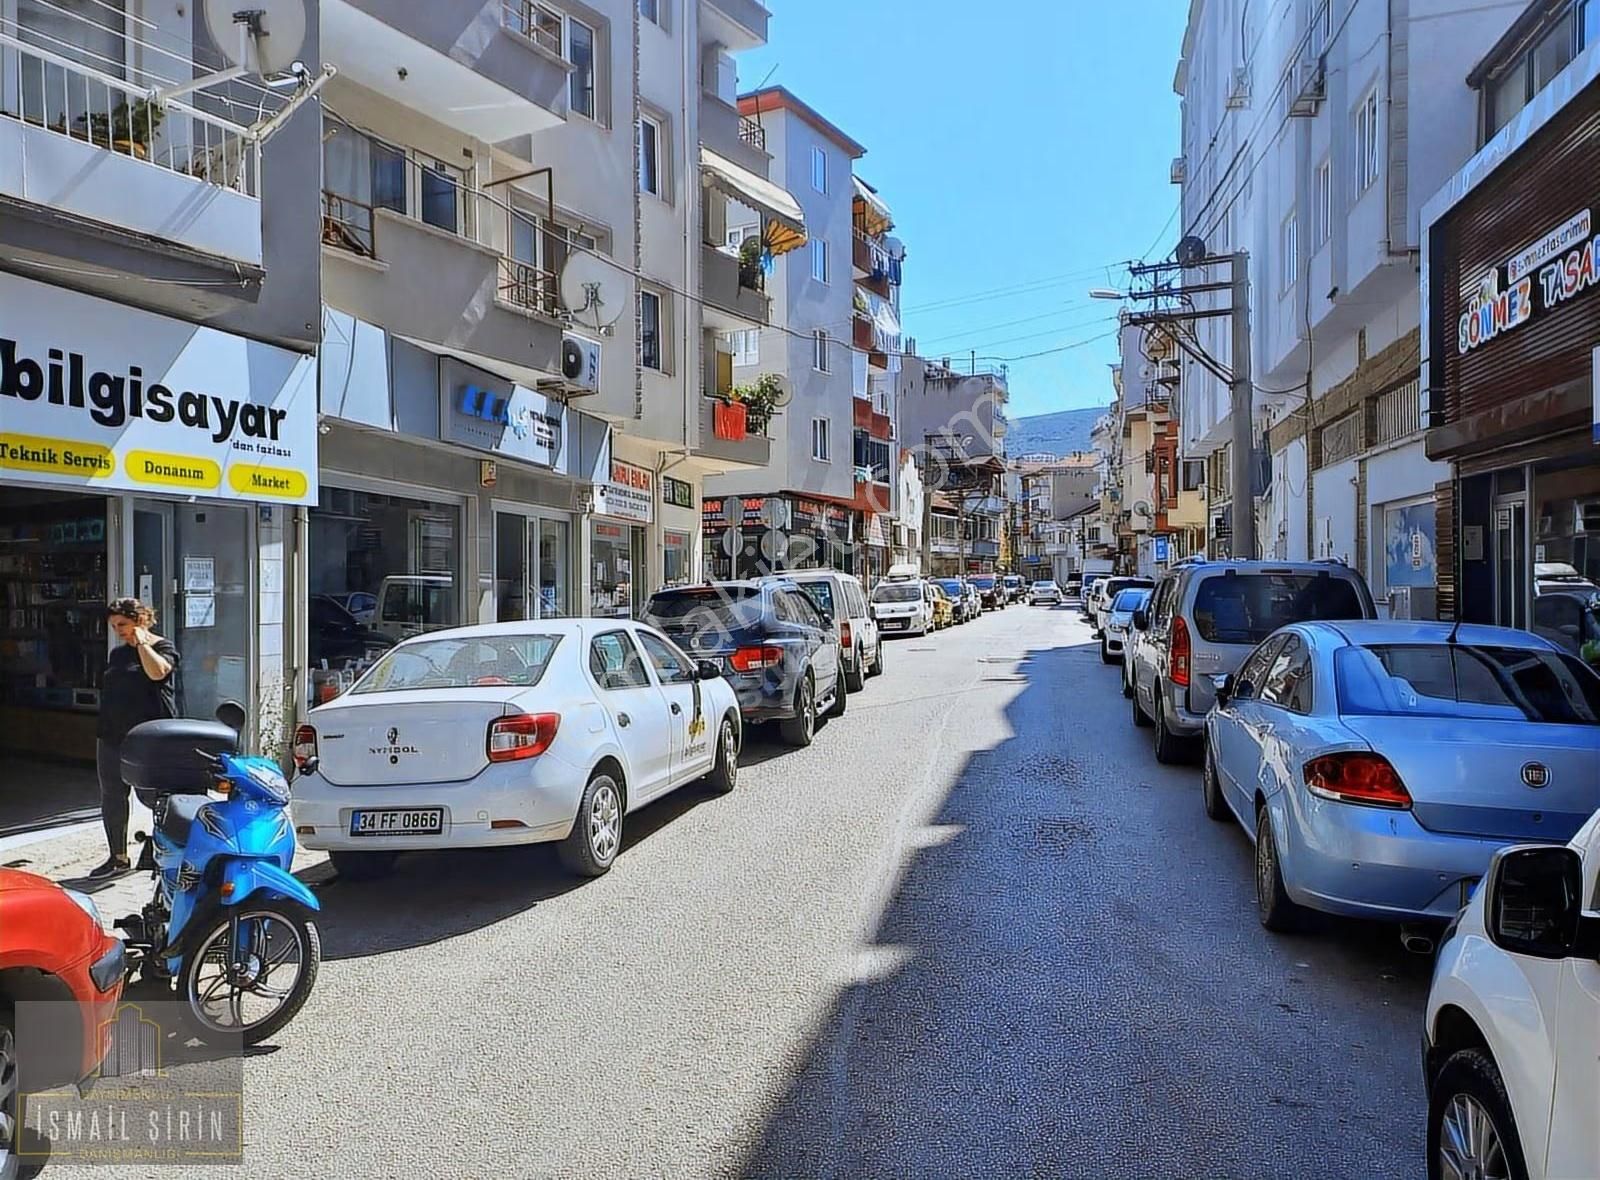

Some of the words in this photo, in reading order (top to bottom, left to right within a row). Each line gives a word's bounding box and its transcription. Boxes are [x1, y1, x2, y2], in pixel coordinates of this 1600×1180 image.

[1459, 279, 1531, 352] SÖNMEZ
[0, 338, 286, 443] bilgisayar
[0, 443, 58, 464] Teknik
[63, 450, 111, 470] Servis
[144, 460, 204, 480] Donanım
[251, 473, 290, 489] Market
[360, 814, 375, 830] 34
[381, 812, 397, 829] FF
[403, 811, 438, 829] 0866
